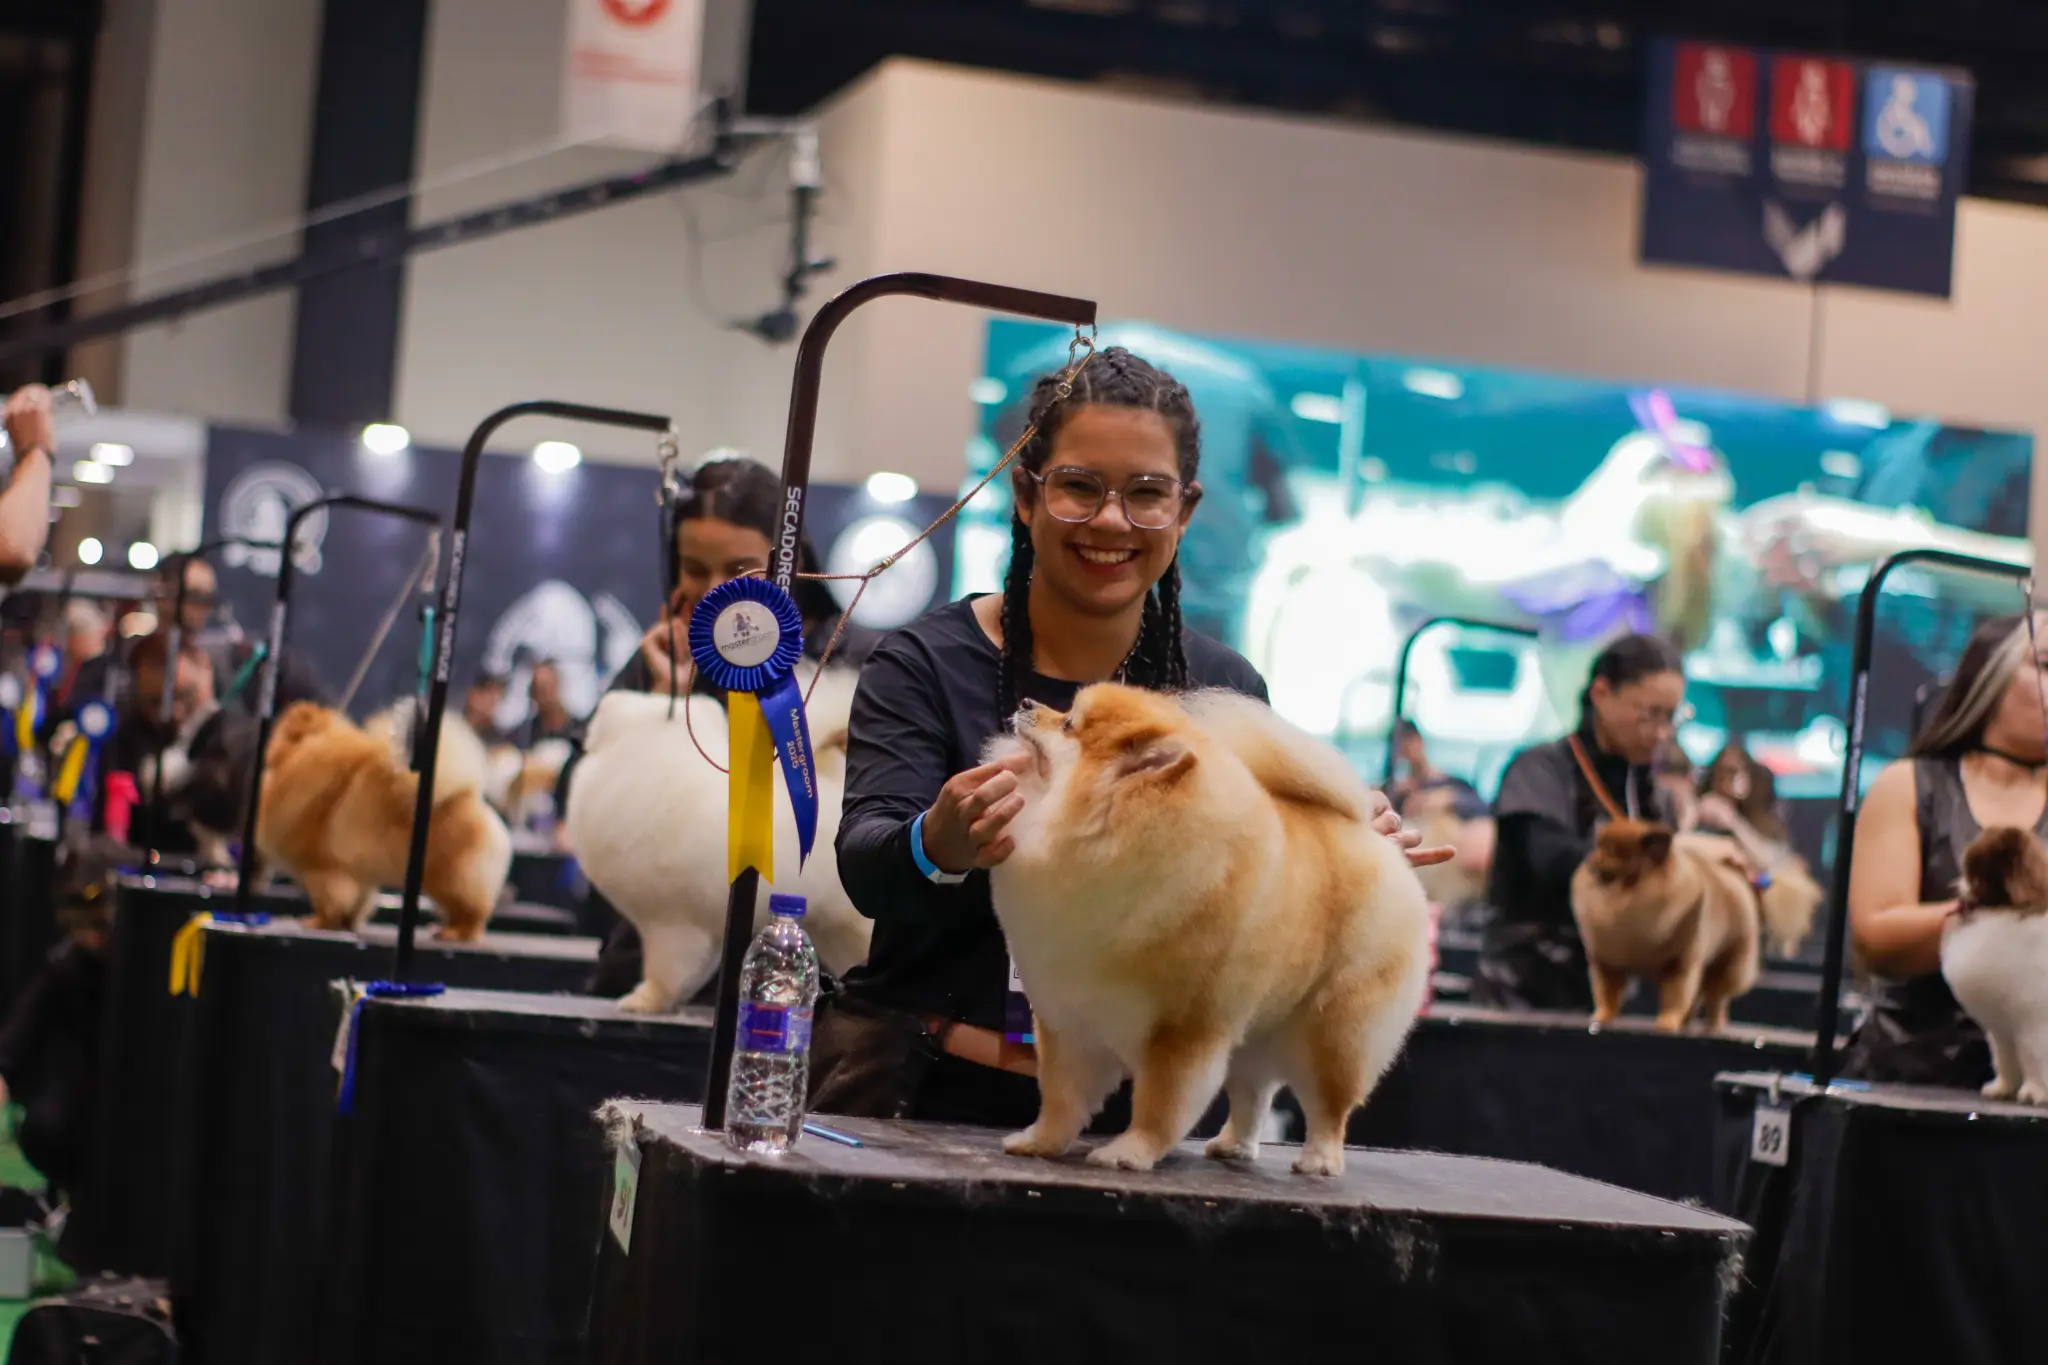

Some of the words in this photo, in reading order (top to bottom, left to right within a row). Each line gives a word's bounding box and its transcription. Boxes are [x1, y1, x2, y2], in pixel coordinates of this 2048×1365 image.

[786, 740, 800, 769] 2025
[790, 708, 813, 799] Mastergroom
[1759, 1123, 1781, 1154] 89
